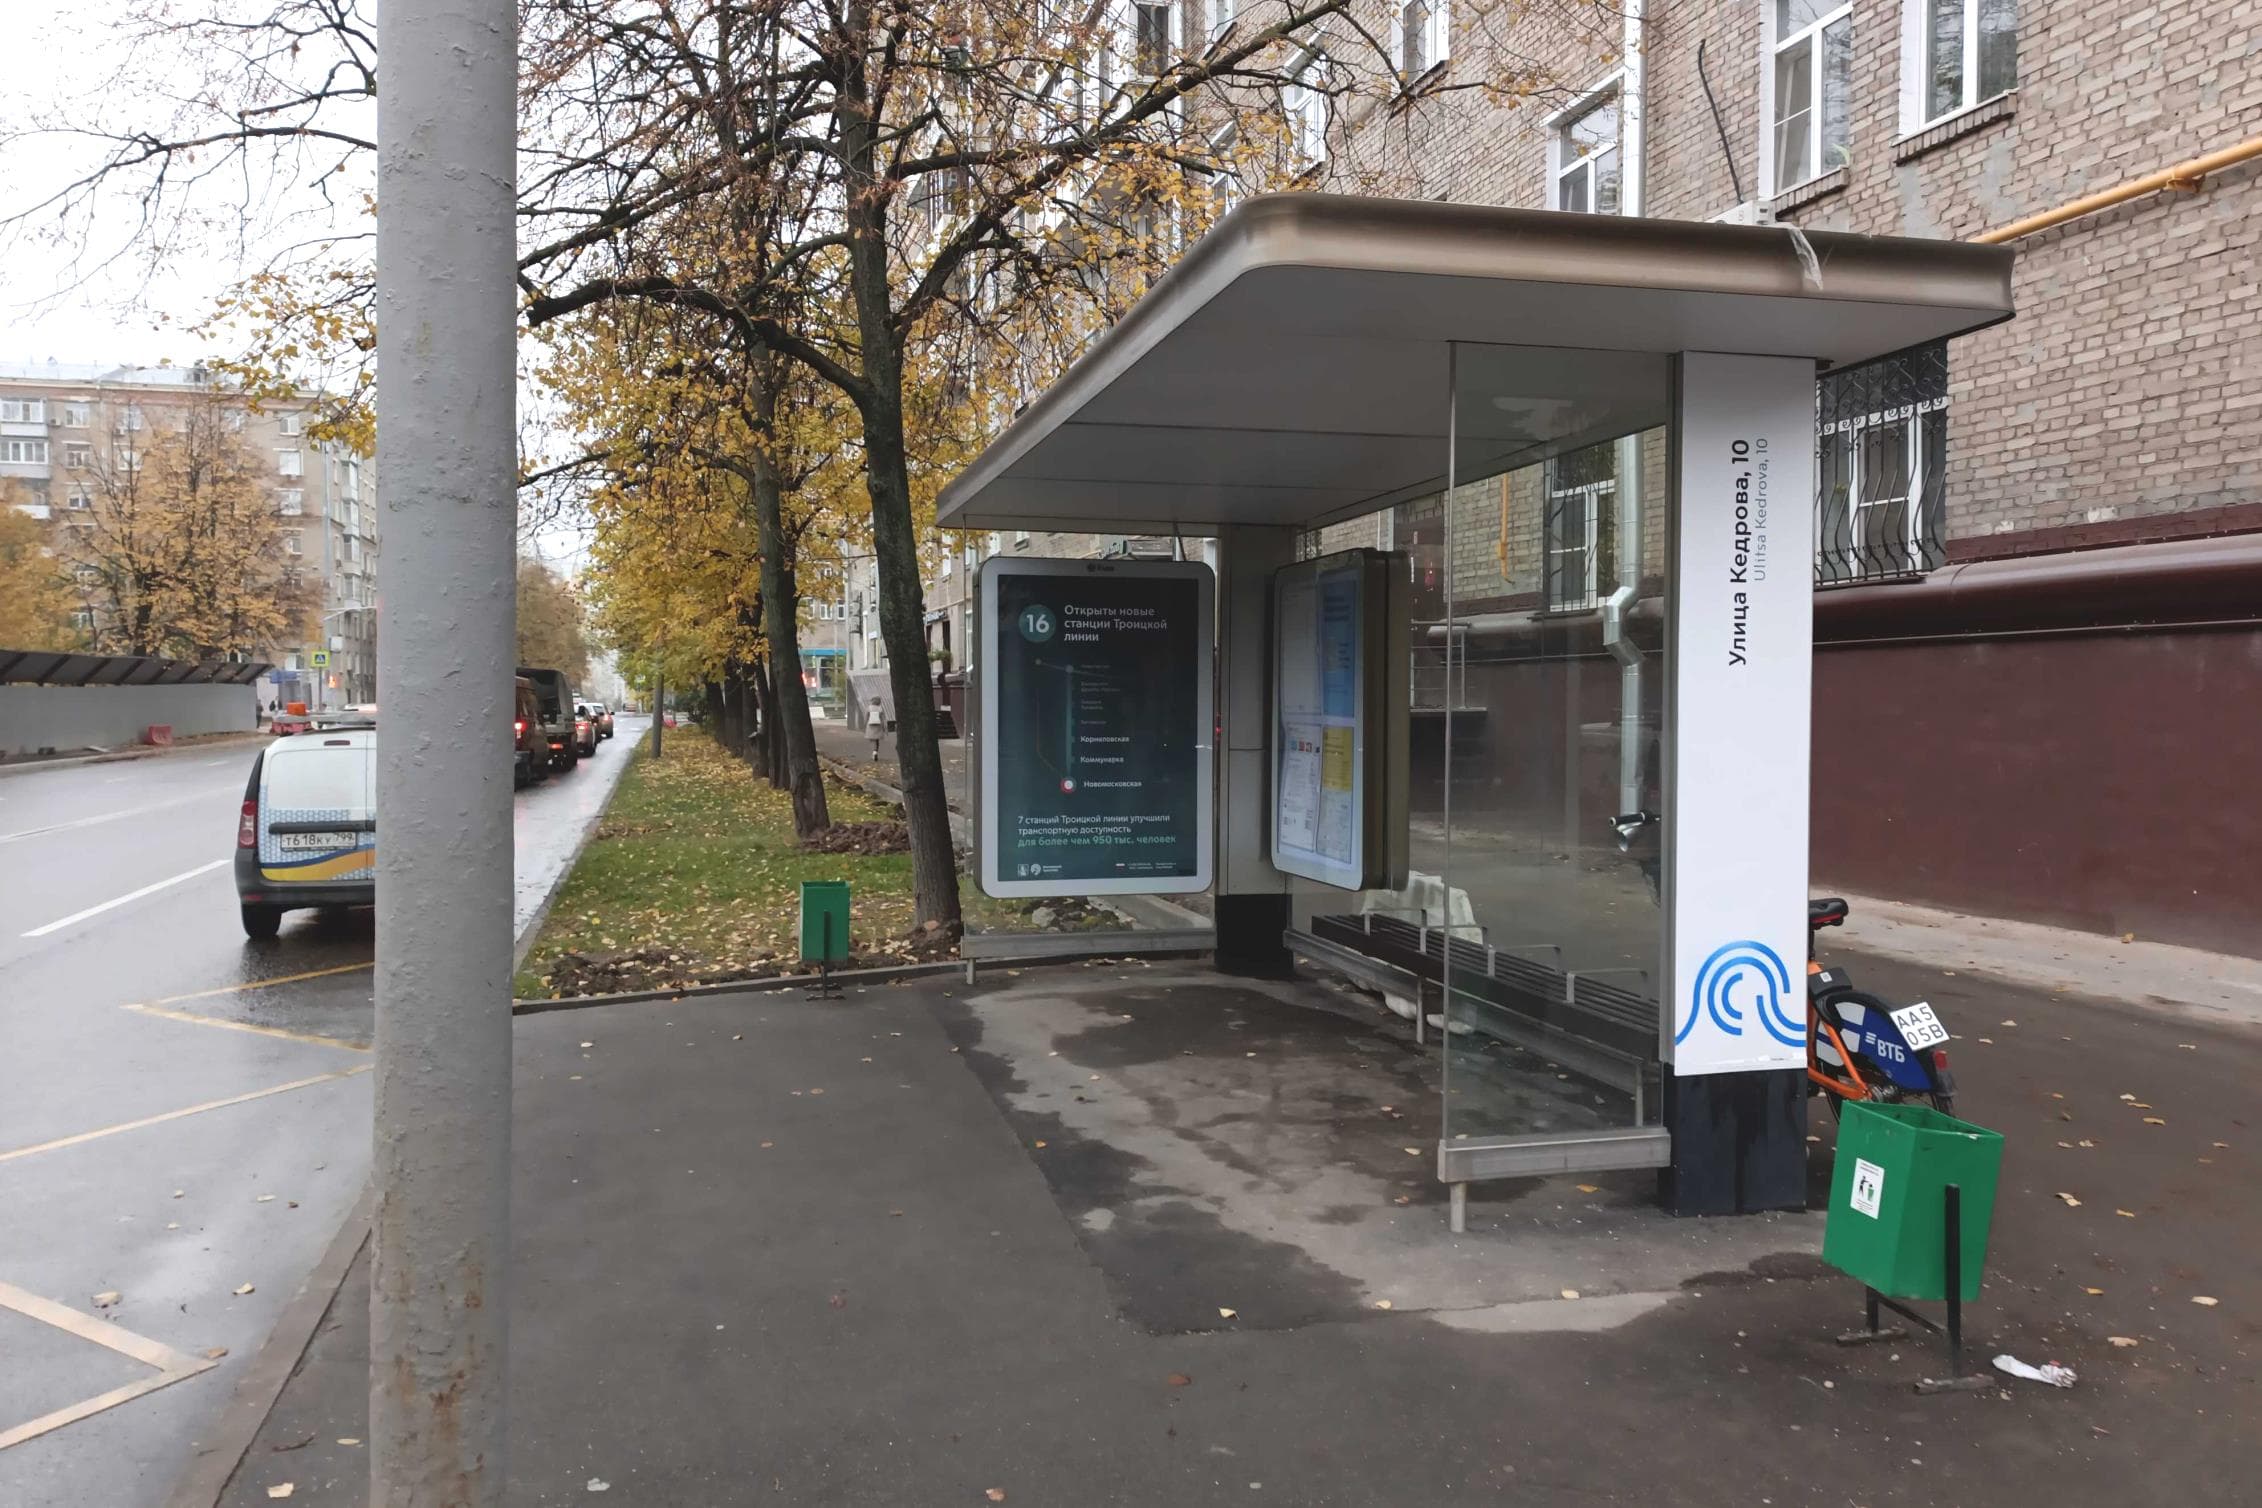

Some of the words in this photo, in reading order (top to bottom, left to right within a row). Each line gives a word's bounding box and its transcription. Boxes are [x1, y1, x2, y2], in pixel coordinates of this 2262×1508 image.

[1731, 439, 1750, 465] 10
[1756, 438, 1769, 454] 10
[1754, 459, 1770, 529] Kedrova,
[1730, 472, 1752, 583] Кедрова,
[1754, 534, 1767, 582] Ulitsa
[1064, 604, 1116, 617] Открыты
[1119, 608, 1155, 616] новые
[1026, 613, 1050, 633] 16
[1064, 619, 1110, 630] станции
[1113, 618, 1167, 631] Троицкой
[1729, 591, 1750, 667] Улица
[1064, 632, 1099, 641] линии
[1018, 815, 1024, 824] 7
[1025, 815, 1059, 825] станций
[1061, 814, 1101, 826] Троицкой
[1103, 815, 1128, 823] линии
[1018, 827, 1078, 836] транспортную
[1080, 825, 1132, 835] доступность
[1018, 838, 1036, 848] для
[1038, 836, 1068, 846] более
[1092, 835, 1112, 845] 950
[1114, 836, 1134, 845] тыс.
[1136, 835, 1176, 844] человек
[1877, 1039, 1905, 1063] ВТБ
